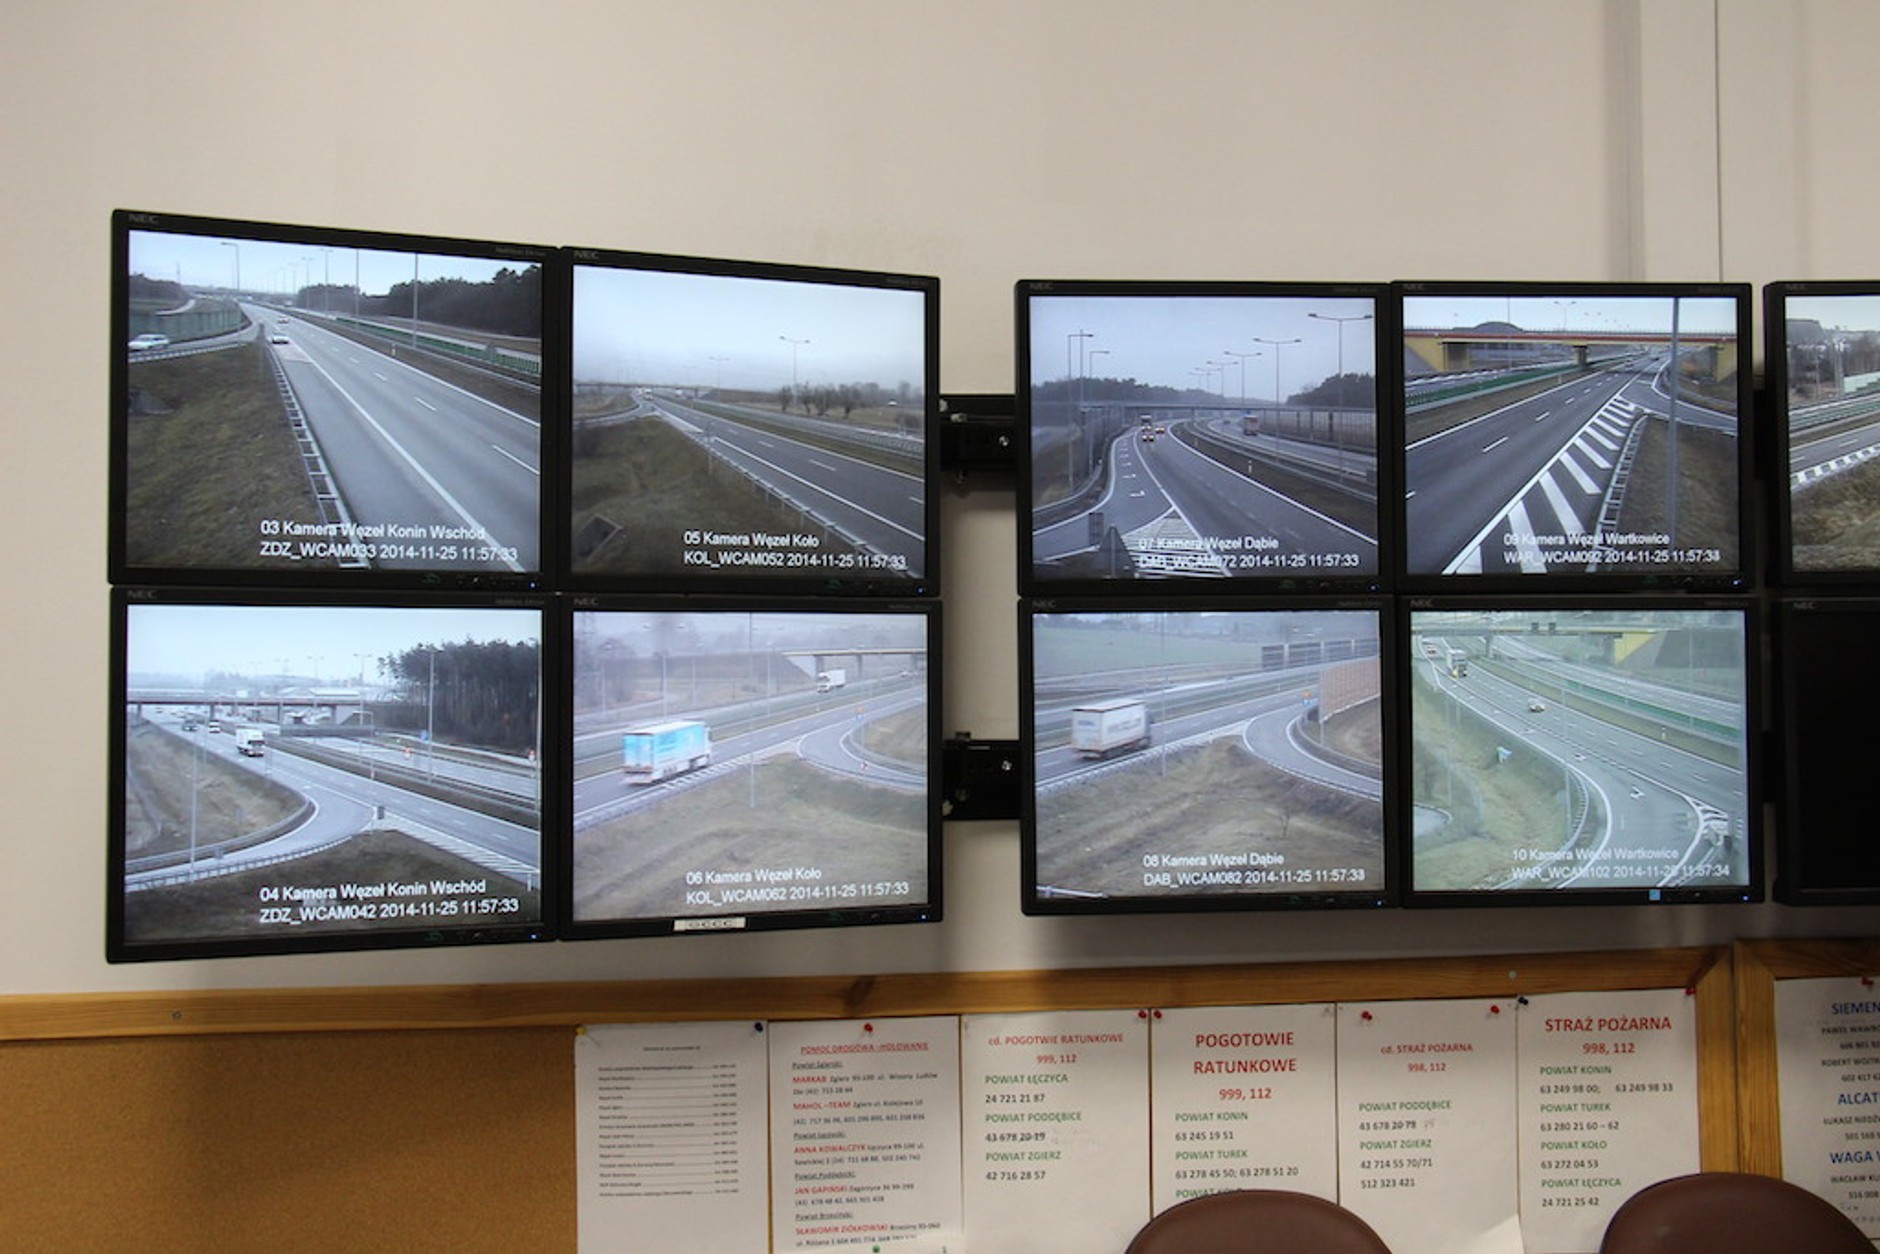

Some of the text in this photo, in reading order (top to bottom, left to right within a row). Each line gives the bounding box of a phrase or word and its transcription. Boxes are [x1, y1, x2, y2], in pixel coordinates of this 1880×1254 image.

[129, 214, 159, 224] NEC
[260, 519, 279, 535] 03
[283, 520, 337, 536] Kamera
[387, 524, 427, 539] Konin
[684, 531, 701, 544] 05
[703, 532, 750, 545] Kamera
[259, 541, 518, 561] ZDZ_WCAM033 2014-11-25 11:57:33
[1604, 550, 1670, 563] 2014-11-25
[684, 551, 906, 568] KOL_WCAM052 2014-11-25 11:57:33
[1239, 554, 1359, 568] 2014-11-25 11:57:33
[1161, 854, 1207, 868] Kamera
[1512, 850, 1527, 861] 10
[1530, 849, 1571, 861] Kamera
[705, 871, 751, 884] Kamera
[1245, 870, 1312, 884] 2014-11-25
[1613, 866, 1679, 879] 2014-11-25
[259, 887, 279, 902] 04
[283, 886, 337, 901] Kamera
[387, 881, 428, 897] Konin
[429, 879, 486, 895] Wschód
[686, 881, 910, 907] KOL_WCAM062 2014-11-25 11:57:33
[259, 898, 519, 924] ZDZ_WCAM042 2014-11-25 11:57:33
[1544, 1014, 1672, 1033] STRAŻ POŻARNA
[1005, 1033, 1124, 1045] POGOTWIE RATUNKOWE
[1195, 1031, 1294, 1048] POGOTOWIE
[1396, 1042, 1473, 1054] STRAŻ POŻARNA
[1582, 1042, 1635, 1056] 998, 112
[1037, 1053, 1077, 1064] 999, 112
[1193, 1057, 1297, 1074] RATUNKOWE
[1408, 1062, 1446, 1072] 998, 112
[1539, 1064, 1612, 1075] POWIAT KONIN
[985, 1073, 1069, 1085] POWIAT ŁĘCZYCA
[1219, 1087, 1272, 1101] 999, 112
[1540, 1082, 1673, 1094] 63 249 98 63 249 98 33
[985, 1093, 1045, 1103] 24 721 21 87
[1358, 1099, 1452, 1112] POWIAT PODDĘBICE
[1540, 1102, 1612, 1113] POWIAT TUREK
[985, 1111, 1082, 1123] POWIAT PODDĘBICE
[1175, 1111, 1249, 1122] POWIAT KONIN
[1359, 1121, 1371, 1131] 43
[1540, 1120, 1620, 1132] 63 280 21 60 62
[985, 1132, 998, 1142] 43
[1175, 1130, 1234, 1141] 63 245 19 51
[794, 1146, 817, 1154] ANNA
[1360, 1138, 1432, 1150] POWIAT ZGIERZ
[1540, 1140, 1608, 1151] POWIAT KOŁO
[985, 1150, 1062, 1162] POWIAT ZGIERZ
[1175, 1149, 1249, 1160] POWIAT TUREK
[1829, 1150, 1874, 1164] WAGA
[1360, 1157, 1433, 1169] 42 714 55 70/71
[1540, 1159, 1599, 1170] 63 272 04 53
[985, 1170, 1046, 1181] 42 716 28 57
[1175, 1169, 1188, 1179] 63
[1189, 1169, 1207, 1179] 278
[1209, 1169, 1221, 1178] 45
[1239, 1168, 1252, 1177] 63
[1253, 1167, 1271, 1177] 278
[1272, 1167, 1284, 1176] 51
[1286, 1166, 1300, 1176] 20
[1361, 1177, 1415, 1189] 512 323 421
[1541, 1177, 1622, 1189] POWIAT ŁĘCZYCA
[1542, 1196, 1599, 1207] 24 721 25 42
